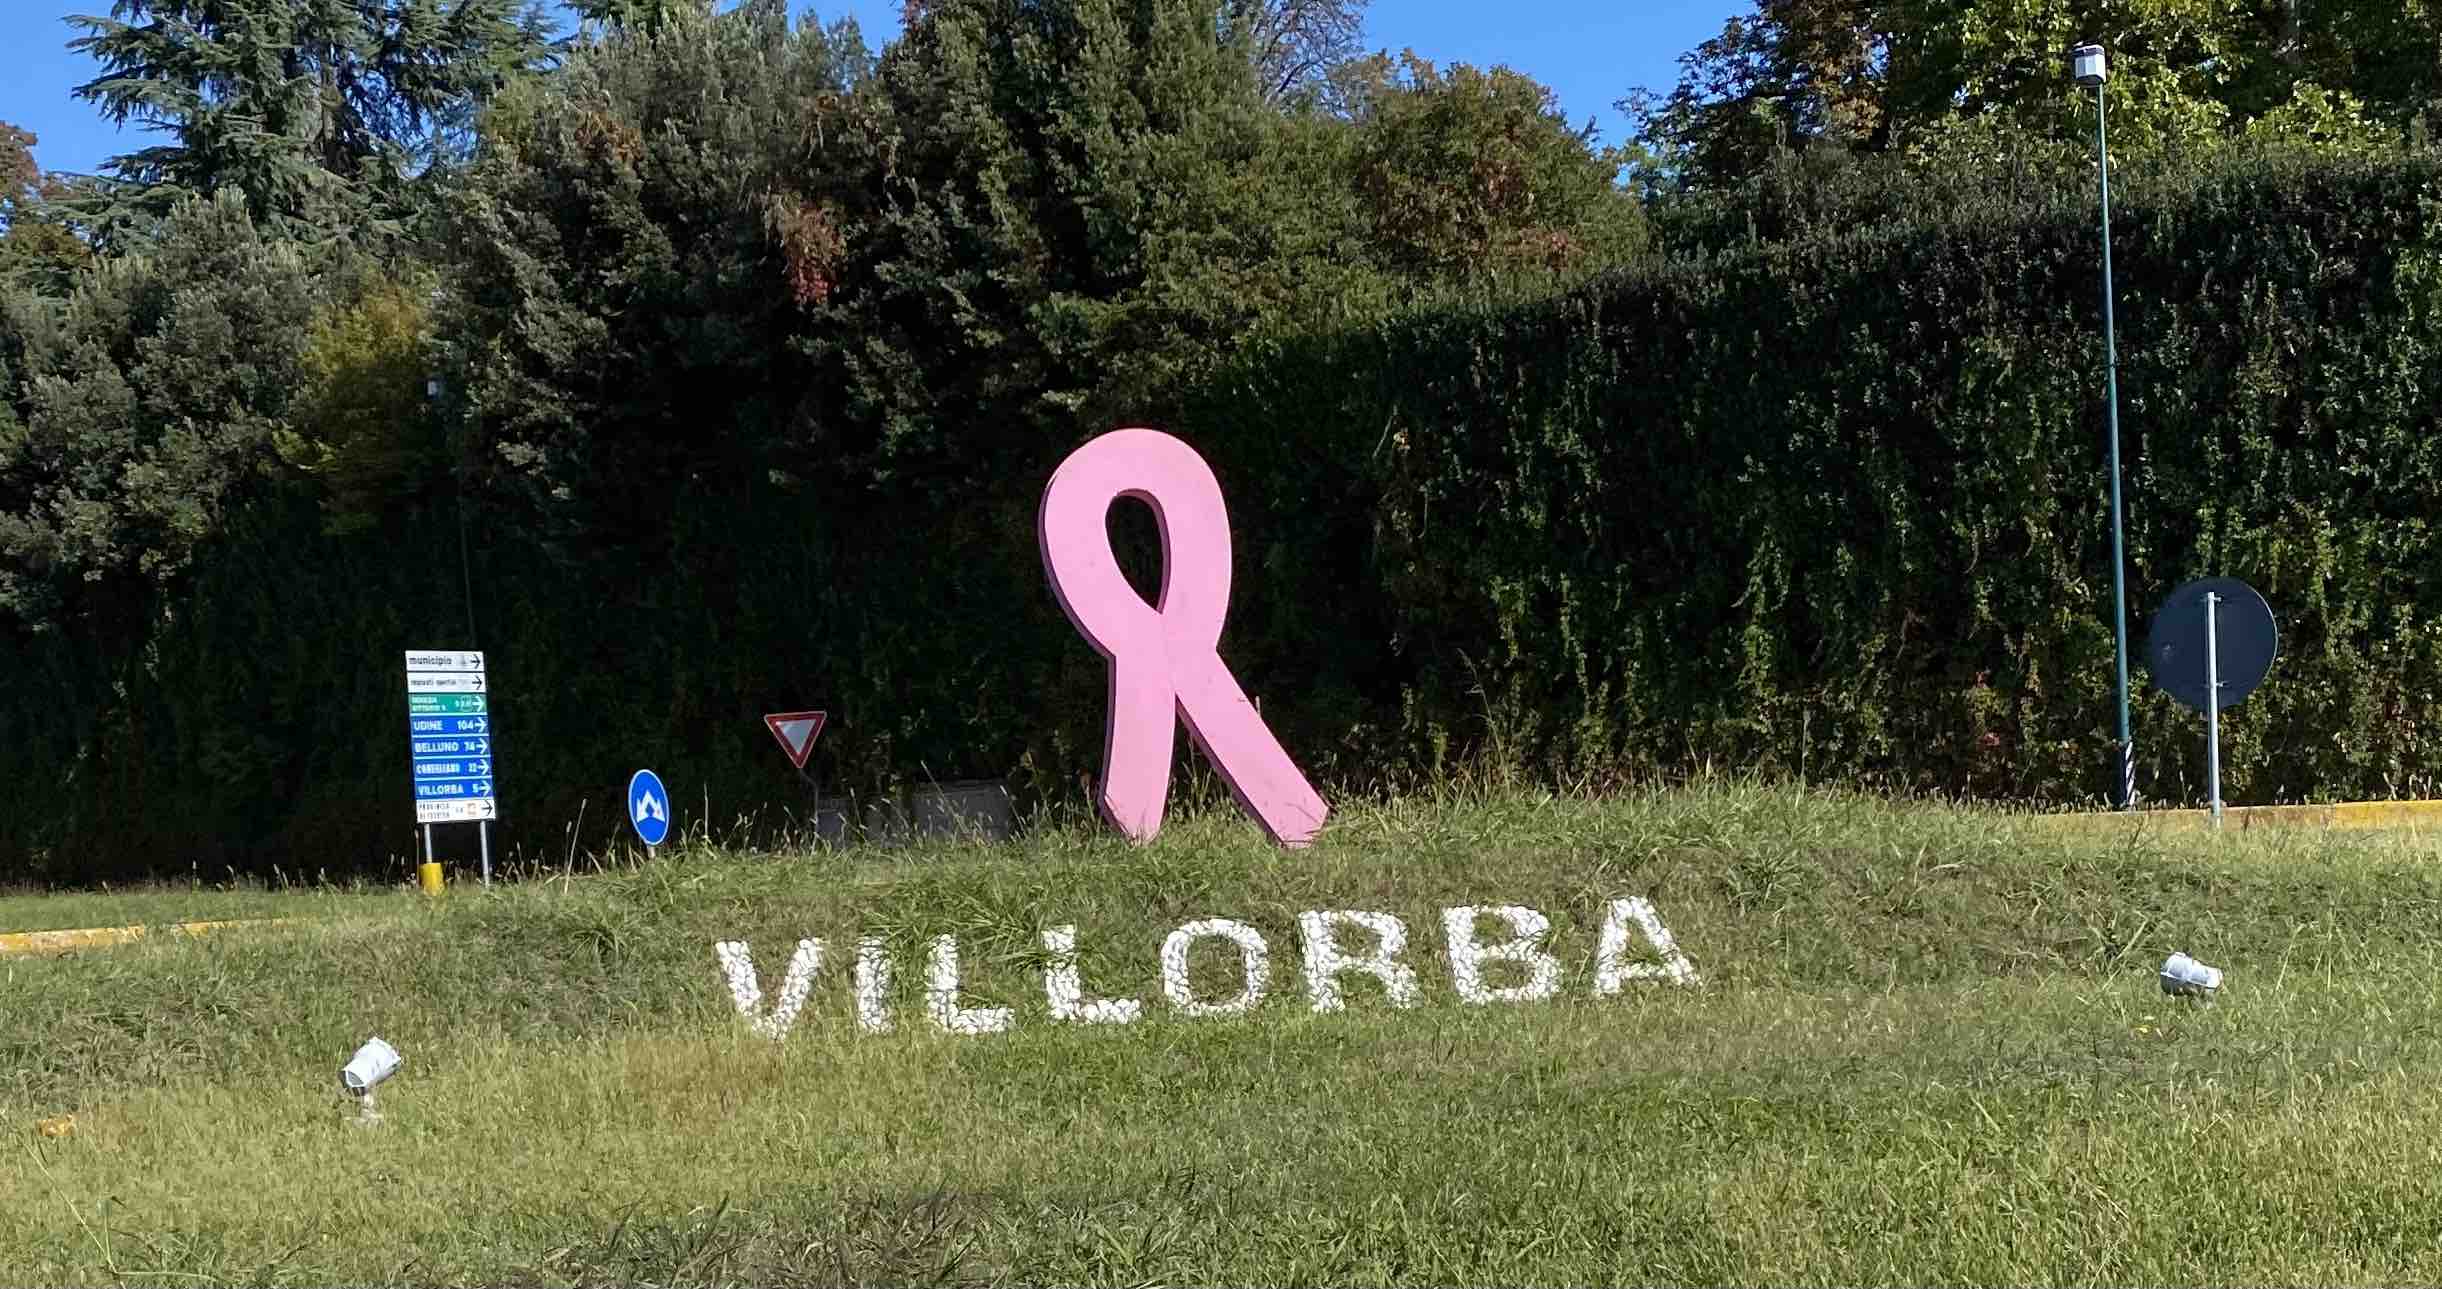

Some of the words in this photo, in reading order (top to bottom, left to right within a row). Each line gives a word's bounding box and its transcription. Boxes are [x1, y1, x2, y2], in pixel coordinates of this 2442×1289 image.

[408, 655, 452, 666] municipio
[414, 719, 443, 731] UDINE
[456, 719, 474, 731] 104
[415, 741, 459, 752] BELLUNO
[463, 741, 475, 752] 74
[417, 783, 464, 796] VILLORBA
[715, 896, 1698, 1041] VILLORBA
